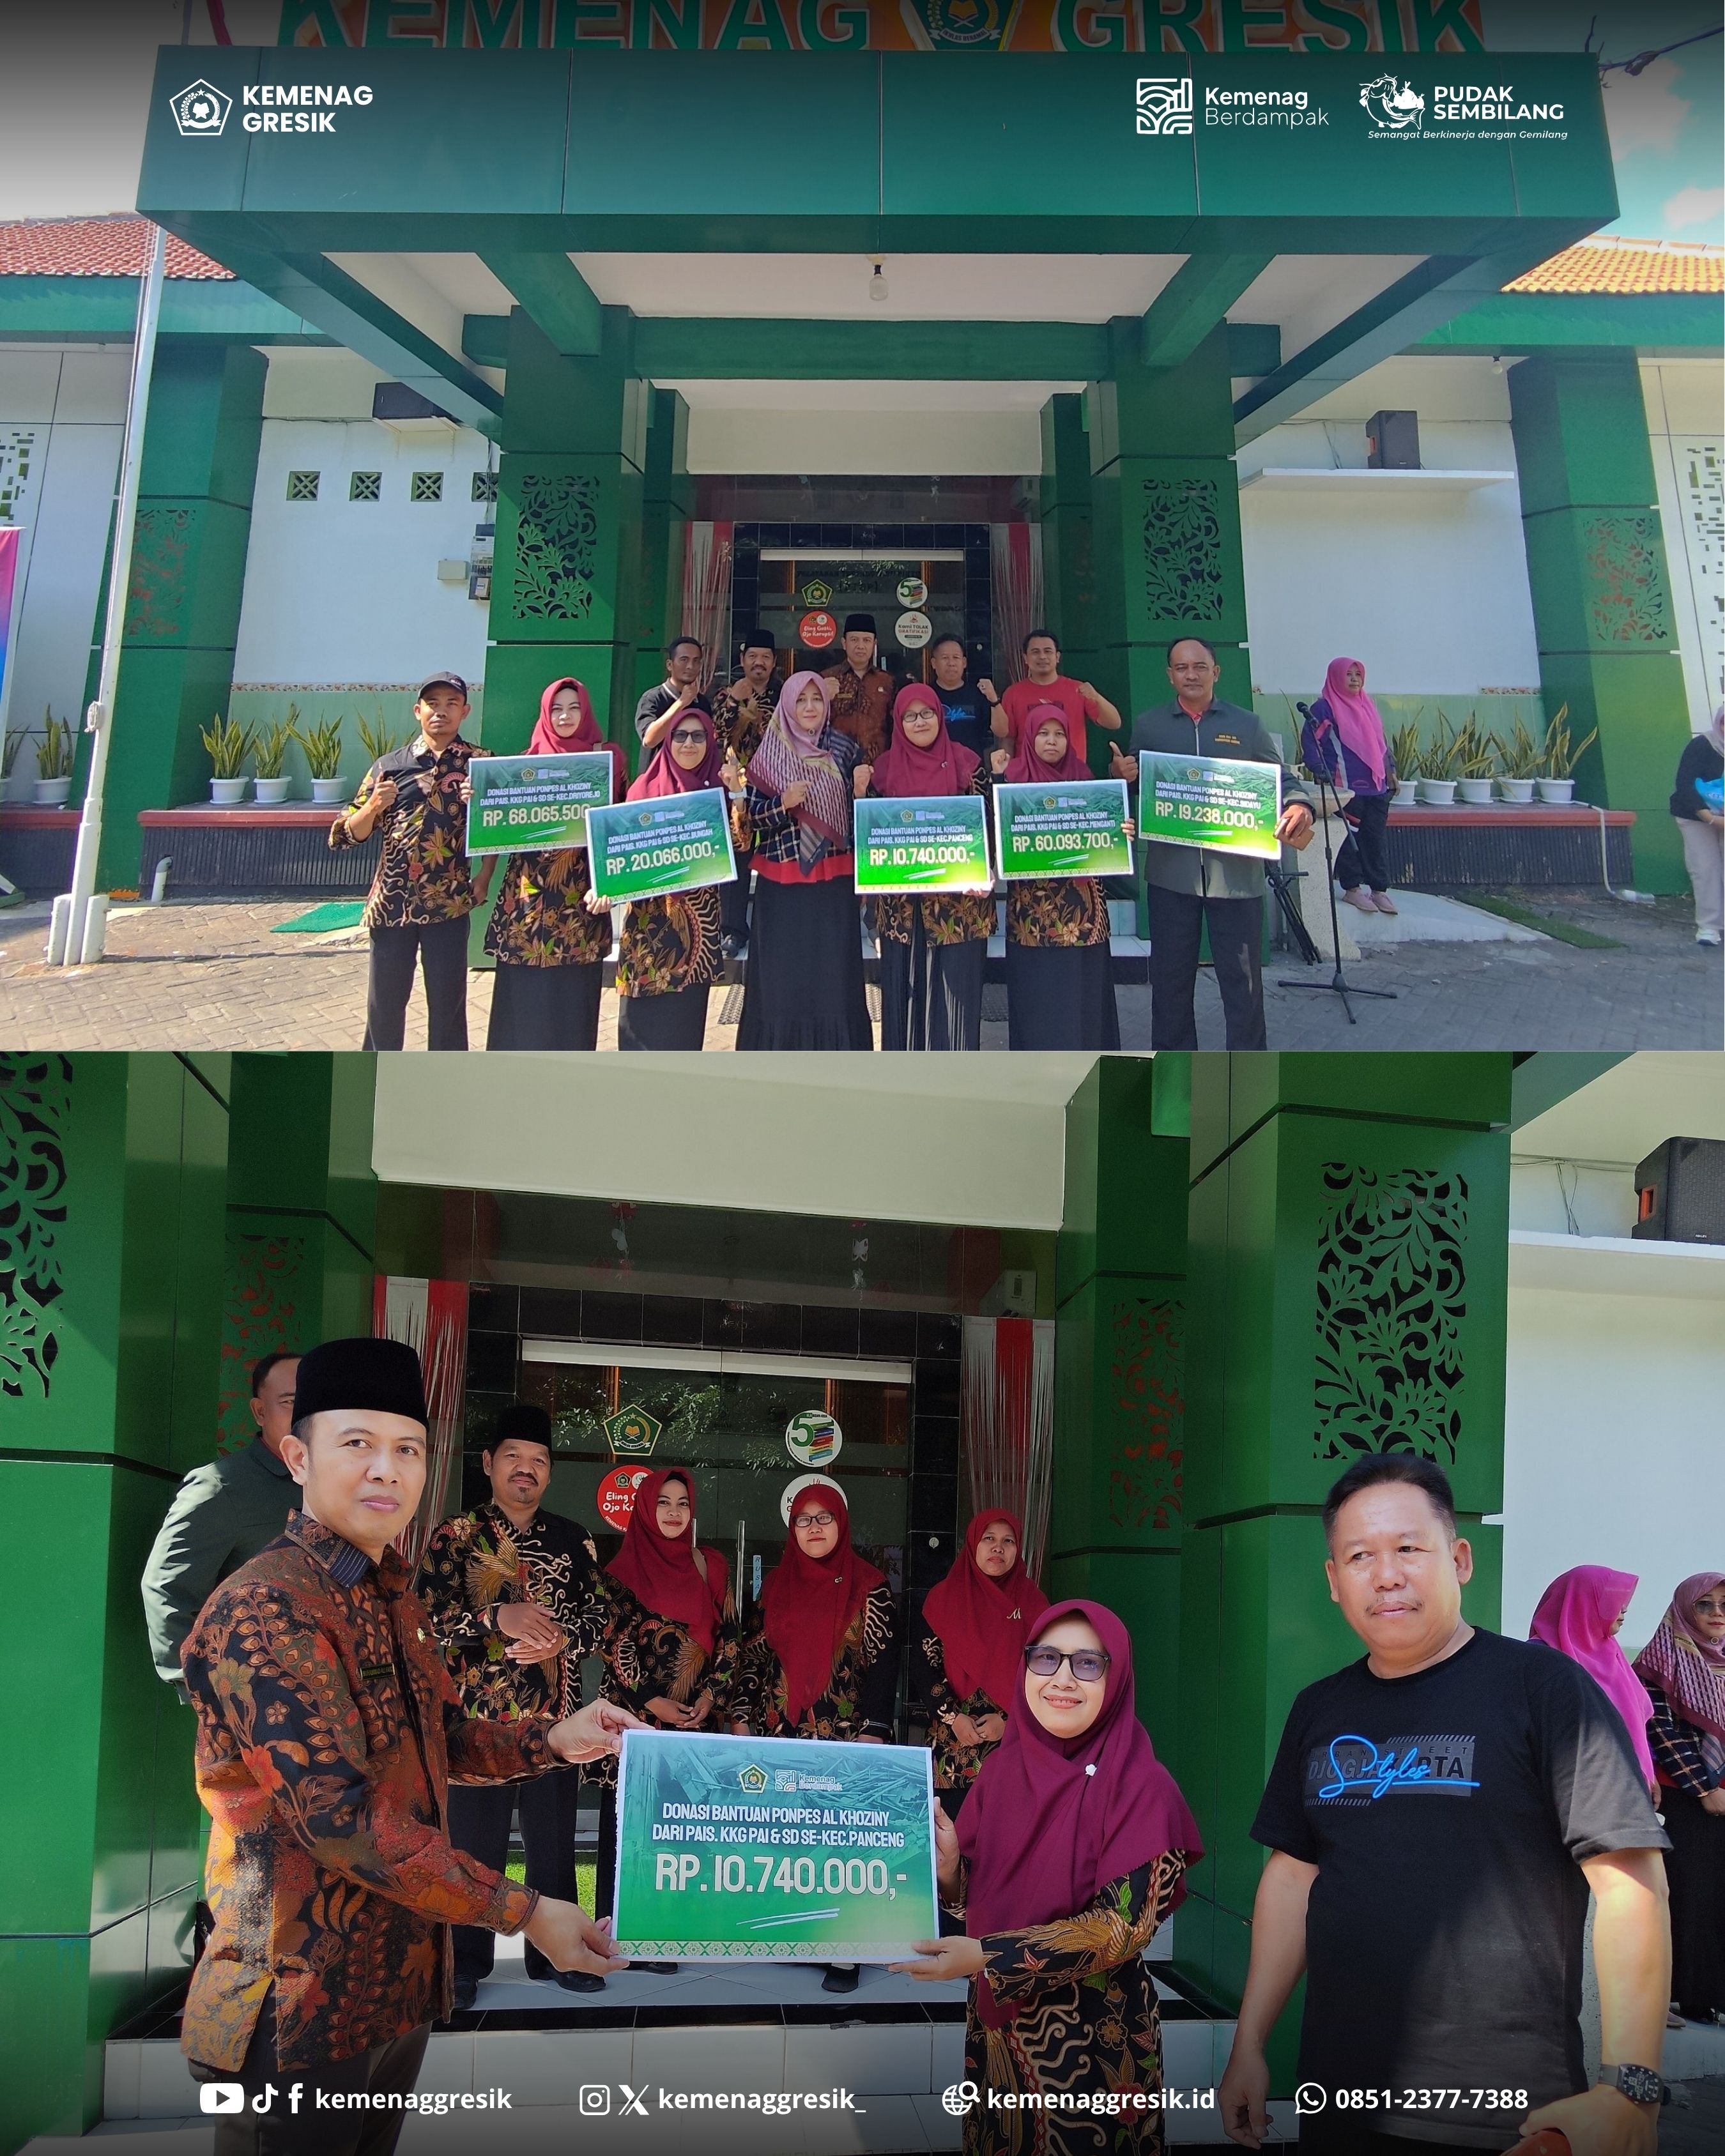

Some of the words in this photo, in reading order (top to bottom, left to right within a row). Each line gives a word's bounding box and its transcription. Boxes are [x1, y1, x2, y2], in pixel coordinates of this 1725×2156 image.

[487, 788, 509, 797] DONASI
[509, 786, 536, 795] BANTUAN
[537, 784, 559, 793] PONPES
[567, 783, 592, 791] KHOZINY
[1034, 814, 1058, 822] BANTUAN
[608, 834, 629, 845] DONASI
[629, 830, 656, 842] BANTUAN
[656, 826, 677, 837] PONPES
[677, 824, 684, 832] AL
[684, 820, 707, 831] KHOZINY
[607, 845, 621, 854] DARI
[636, 840, 648, 848] KKG
[606, 1492, 629, 1502] Eling
[602, 1502, 620, 1513] Ojo
[1384, 1746, 1468, 1755] STEET
[1319, 1734, 1480, 1798] Styles
[799, 1773, 836, 1784] Kemenag
[663, 1803, 711, 1821] DONASI
[712, 1805, 770, 1822] BANTUAN
[771, 1807, 820, 1824] PONPES
[822, 1809, 838, 1825] AL
[839, 1810, 889, 1827] KHOZINY
[652, 1824, 684, 1841] DARI
[686, 1825, 718, 1842] PAIS.
[720, 1827, 747, 1844] KKG
[748, 1827, 769, 1844] PAI
[770, 1828, 780, 1845] &
[781, 1828, 799, 1846] SD
[801, 1828, 905, 1847] SE-KEC.PANCENG
